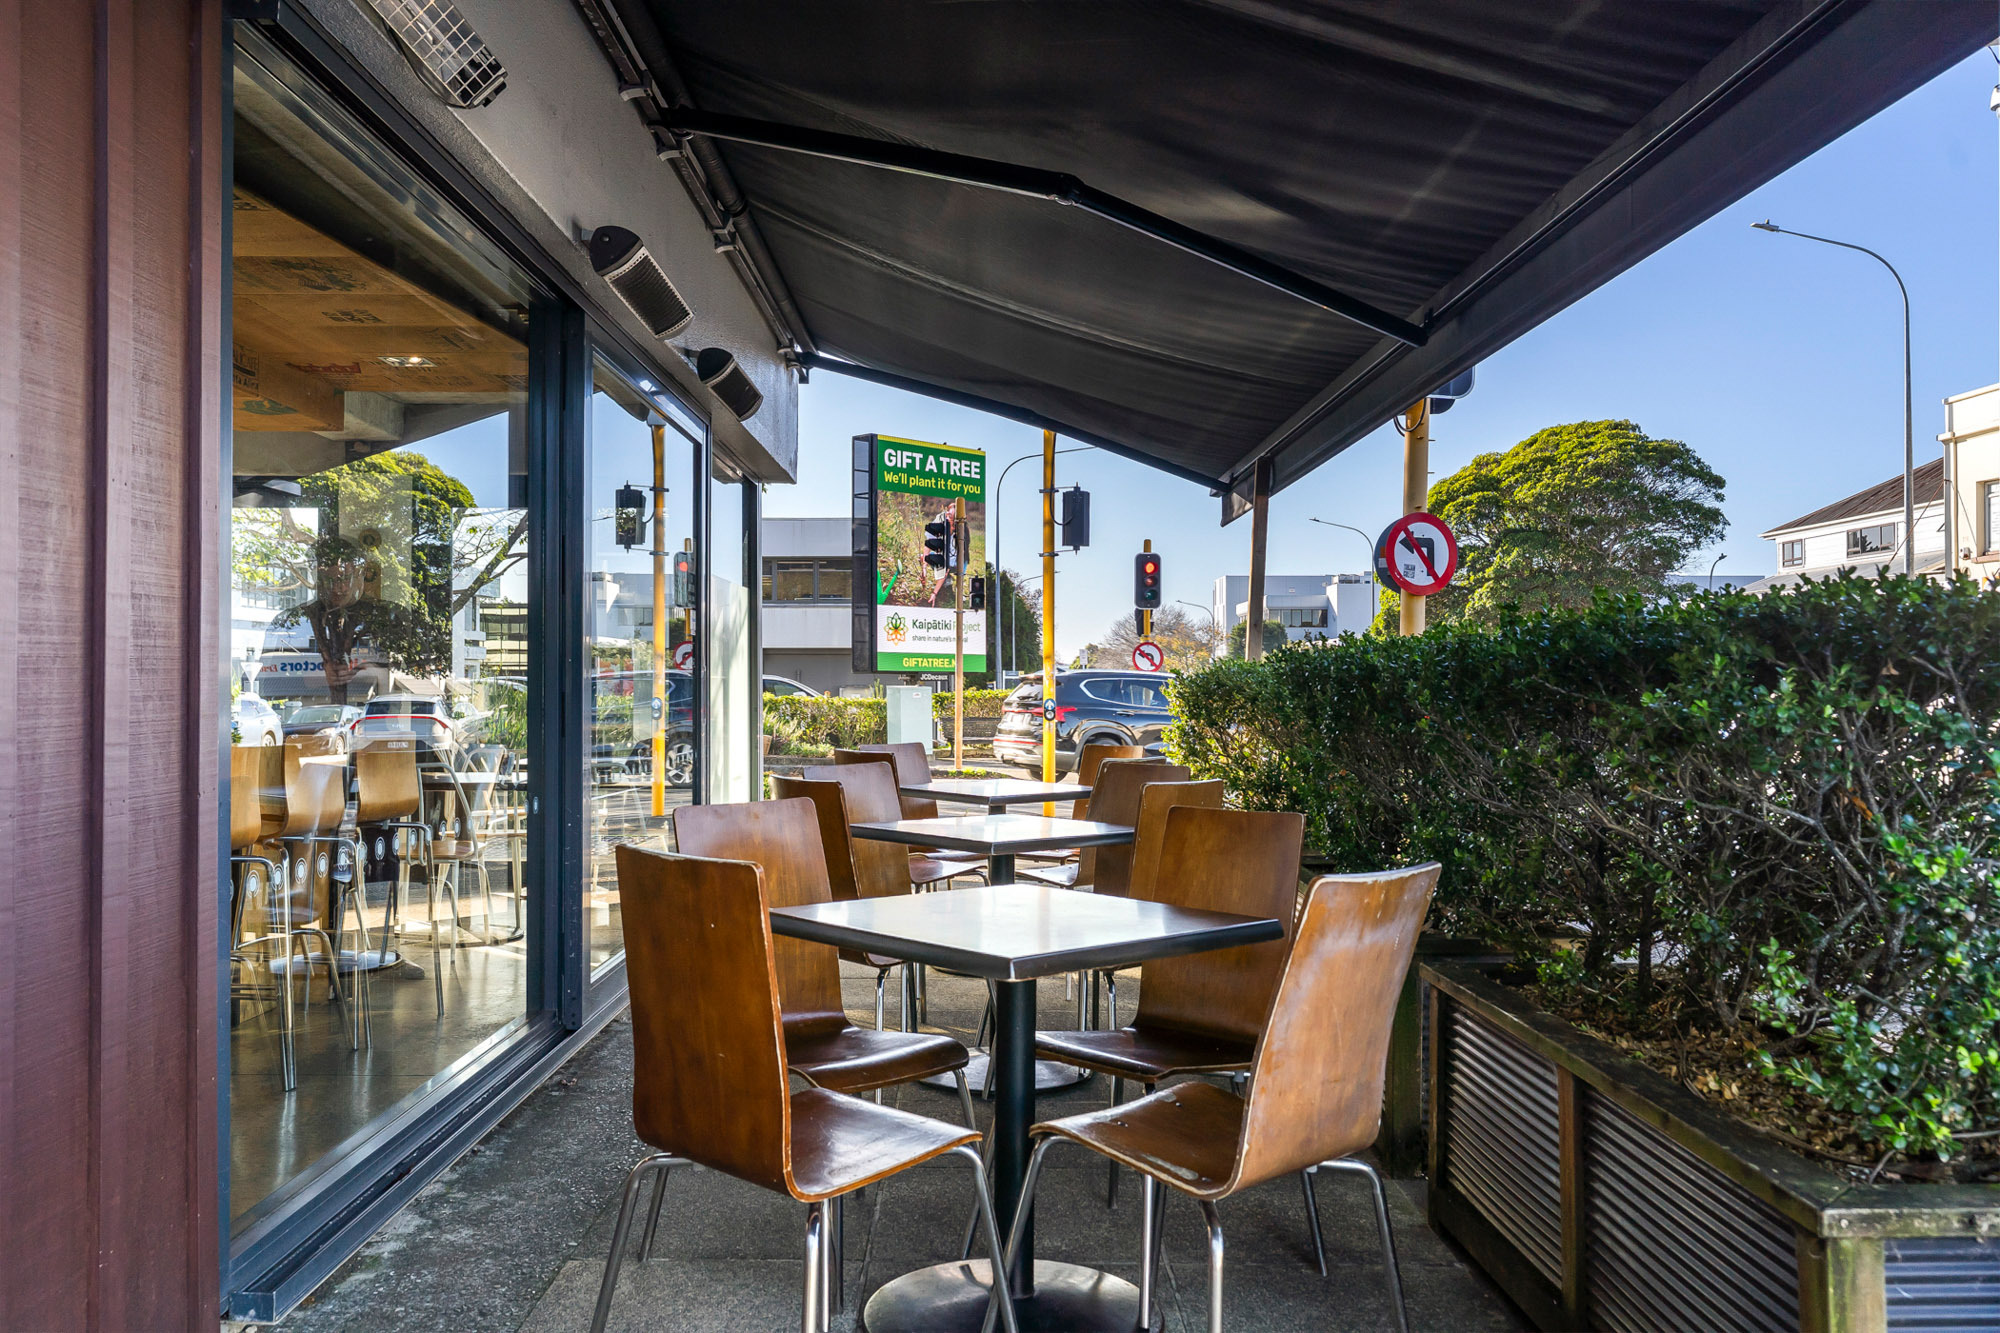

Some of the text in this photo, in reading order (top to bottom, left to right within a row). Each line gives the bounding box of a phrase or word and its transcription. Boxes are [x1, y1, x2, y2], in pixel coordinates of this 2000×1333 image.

[884, 448, 981, 479] GIFT A TREE
[884, 470, 980, 495] We'll plant it for you
[953, 620, 981, 635] Poject
